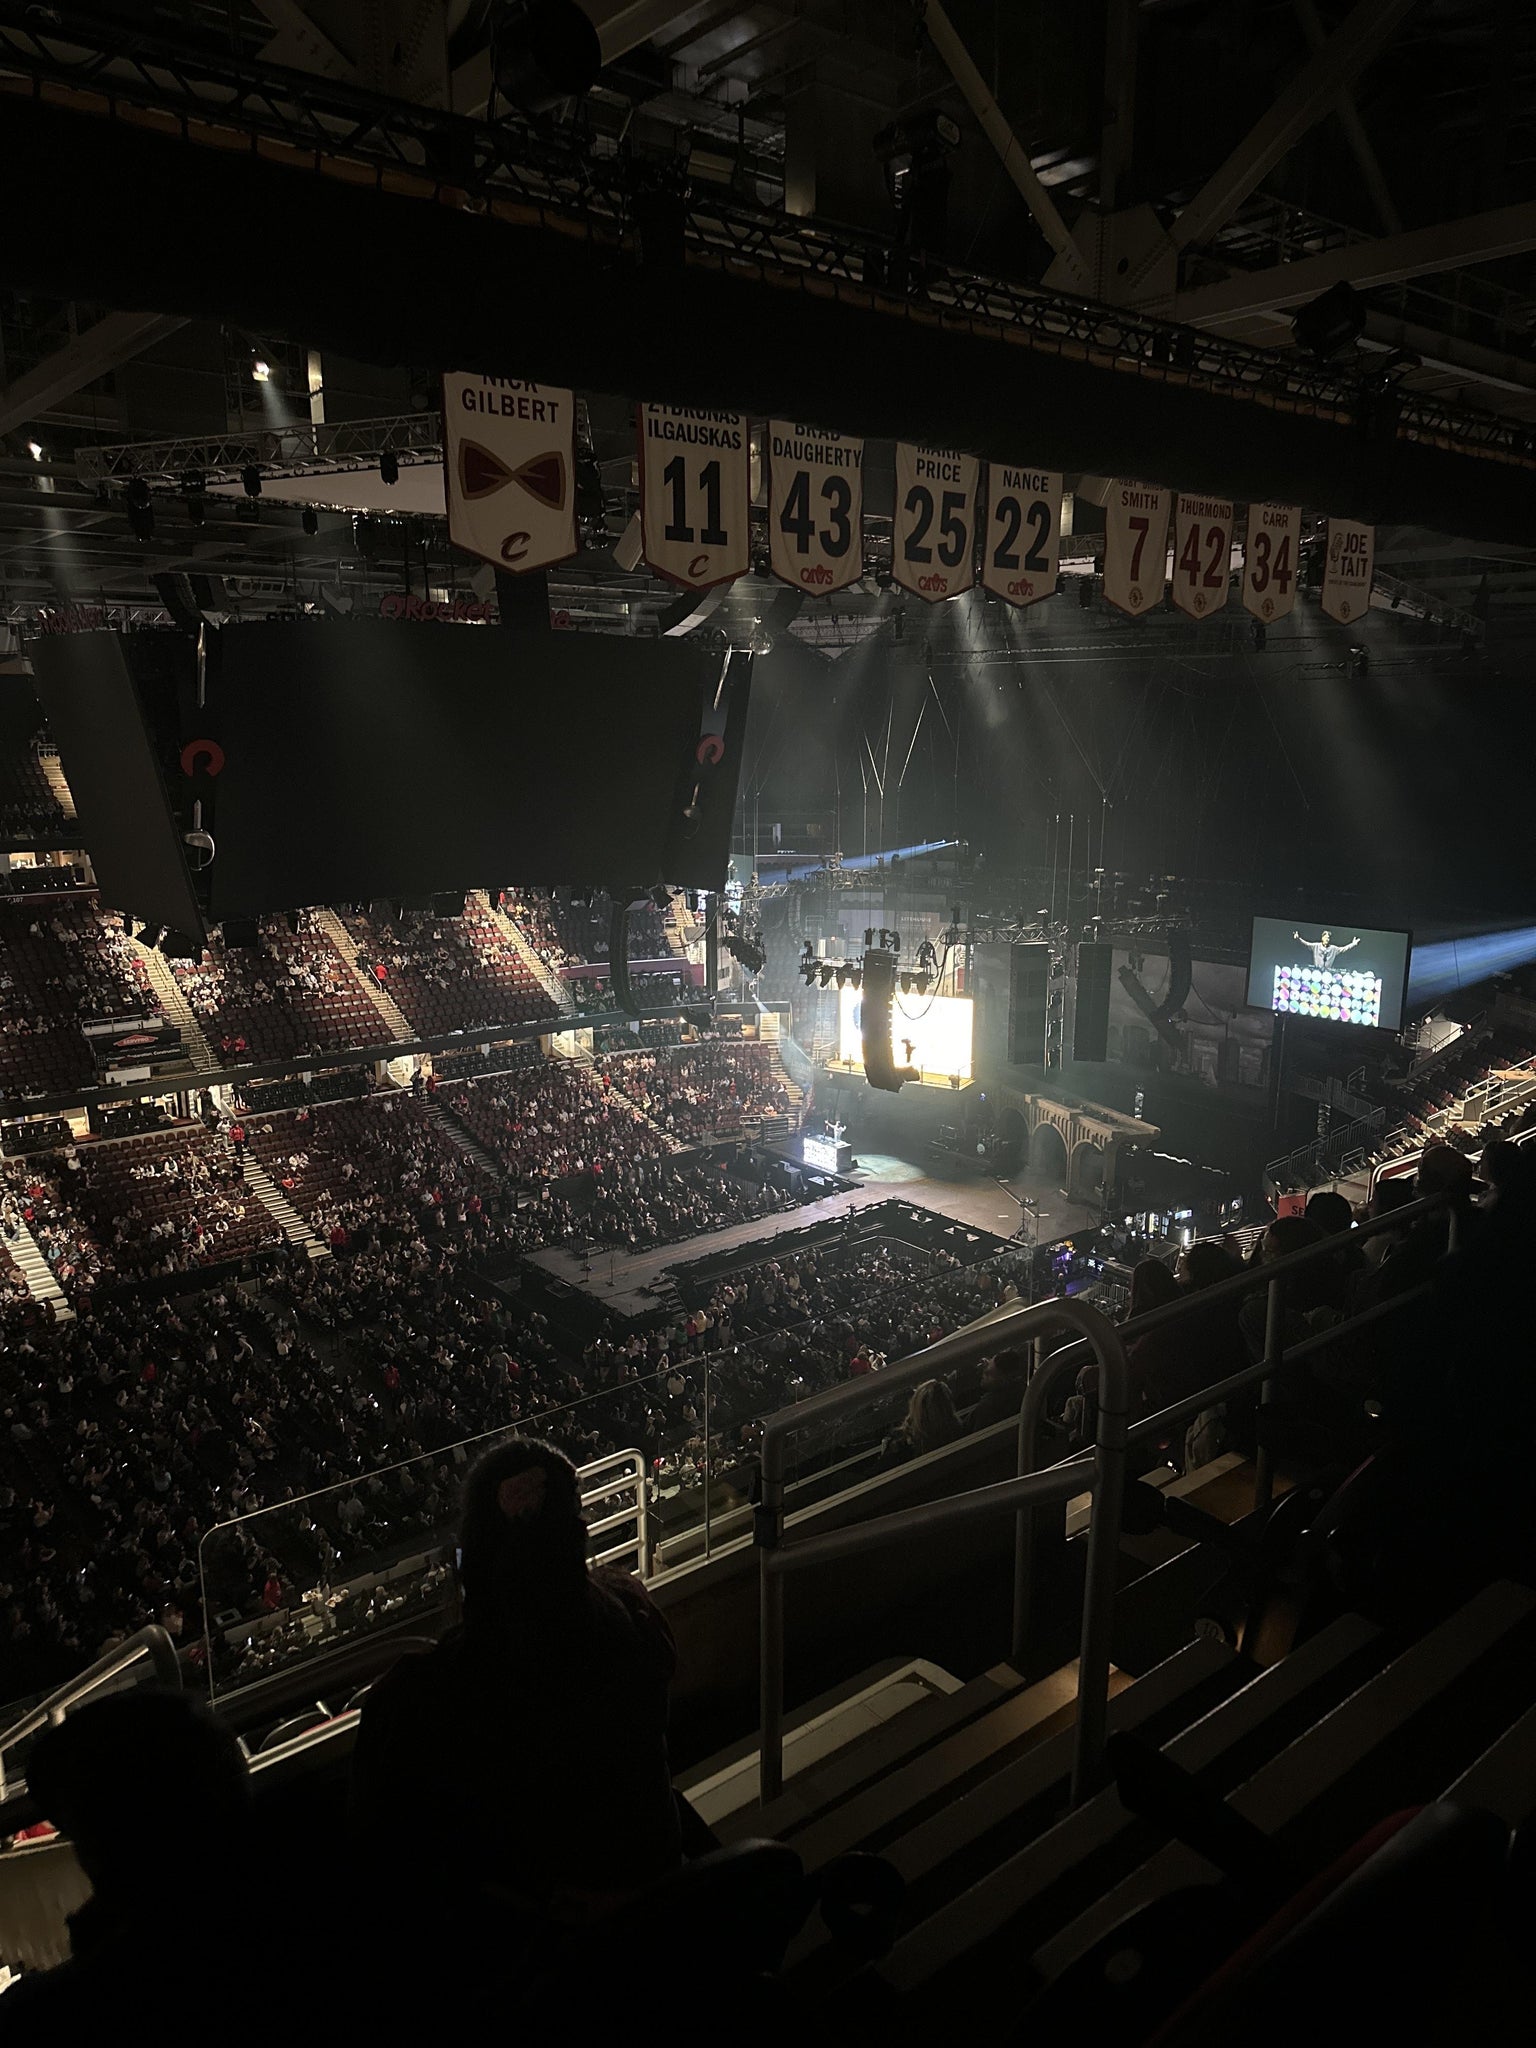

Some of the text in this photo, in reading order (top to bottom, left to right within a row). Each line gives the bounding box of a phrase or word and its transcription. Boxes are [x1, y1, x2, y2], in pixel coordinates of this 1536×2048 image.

[462, 388, 559, 423] GILBERT
[648, 418, 742, 450] ILGAUSKAS
[773, 437, 862, 468] DAUGHERTY
[916, 458, 961, 483] PRICE
[1003, 470, 1049, 493] NANCE
[664, 456, 728, 546] 11
[780, 471, 851, 557] 43
[1121, 490, 1158, 510] SMITH
[1181, 498, 1231, 520] THURMOND
[904, 485, 966, 567] 25
[993, 496, 1051, 573] 22
[1263, 511, 1289, 528] CARR
[1128, 516, 1149, 581] 7
[1179, 523, 1226, 588] 42
[1343, 532, 1367, 554] JOE
[1251, 532, 1292, 594] 34
[1341, 556, 1368, 577] TAIT
